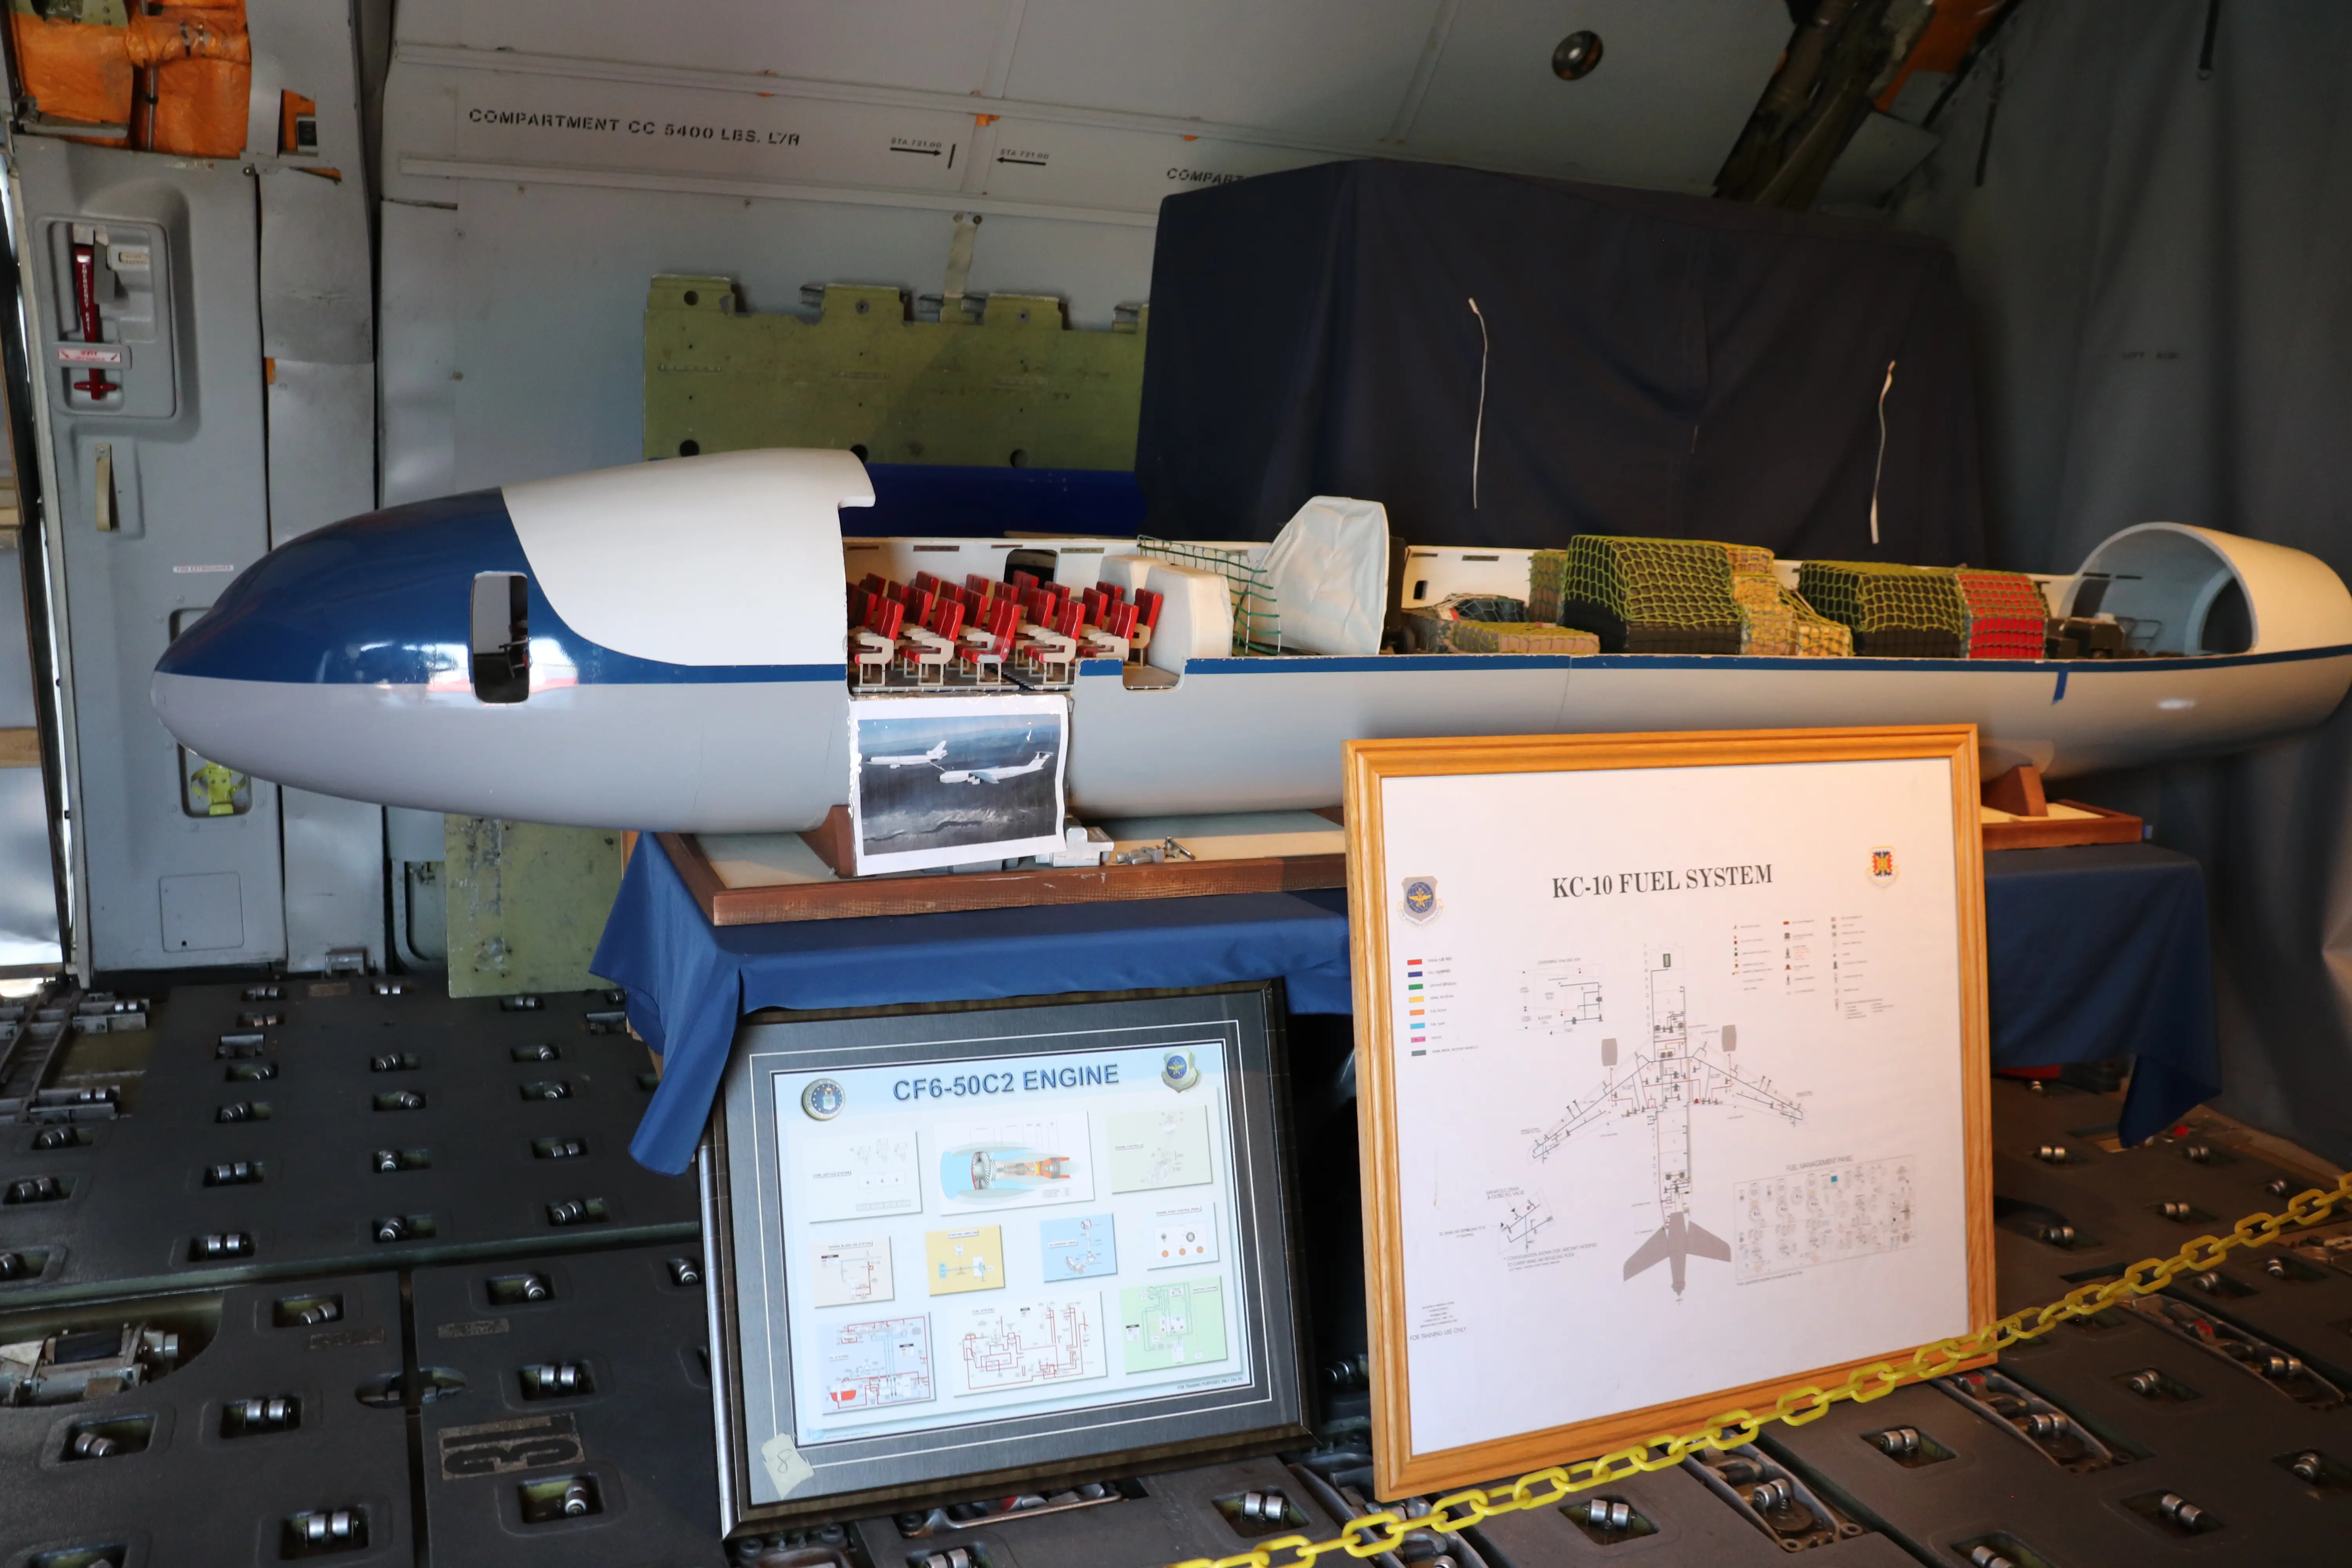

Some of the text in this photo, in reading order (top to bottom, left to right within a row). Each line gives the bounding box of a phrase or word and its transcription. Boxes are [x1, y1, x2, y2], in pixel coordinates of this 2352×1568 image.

[469, 108, 620, 132] COMPARTMENT
[628, 121, 655, 135] CC
[664, 124, 713, 140] 5400
[721, 128, 761, 143] LBS.
[1167, 167, 1245, 185] COMPAR
[1552, 864, 1773, 898] KC-10 FUEL SYSTEM
[893, 1063, 1120, 1100] CF6-50C2 ENGINE
[777, 1448, 793, 1473] 8
